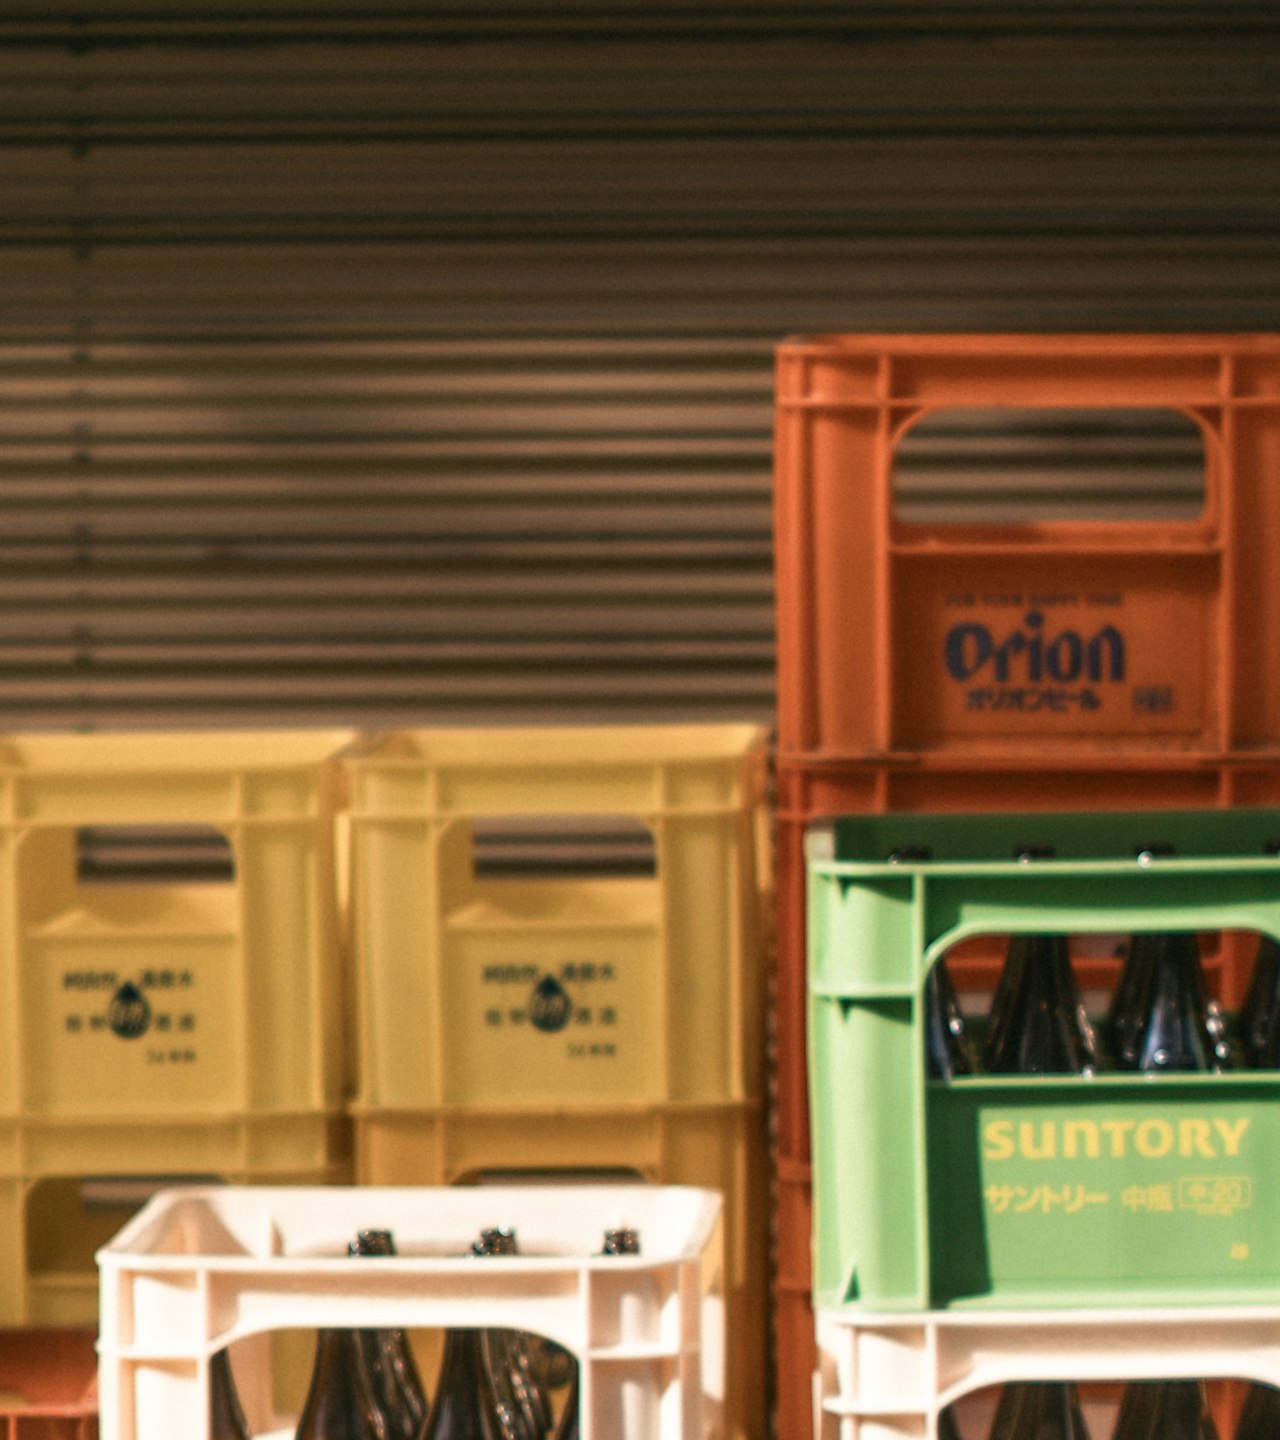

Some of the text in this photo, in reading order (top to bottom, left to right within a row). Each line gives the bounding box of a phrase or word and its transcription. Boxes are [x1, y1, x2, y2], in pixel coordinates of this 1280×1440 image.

[946, 609, 1125, 683] Orion
[984, 1118, 1250, 1159] SUNTORY
[984, 1183, 1110, 1214] サントリー
